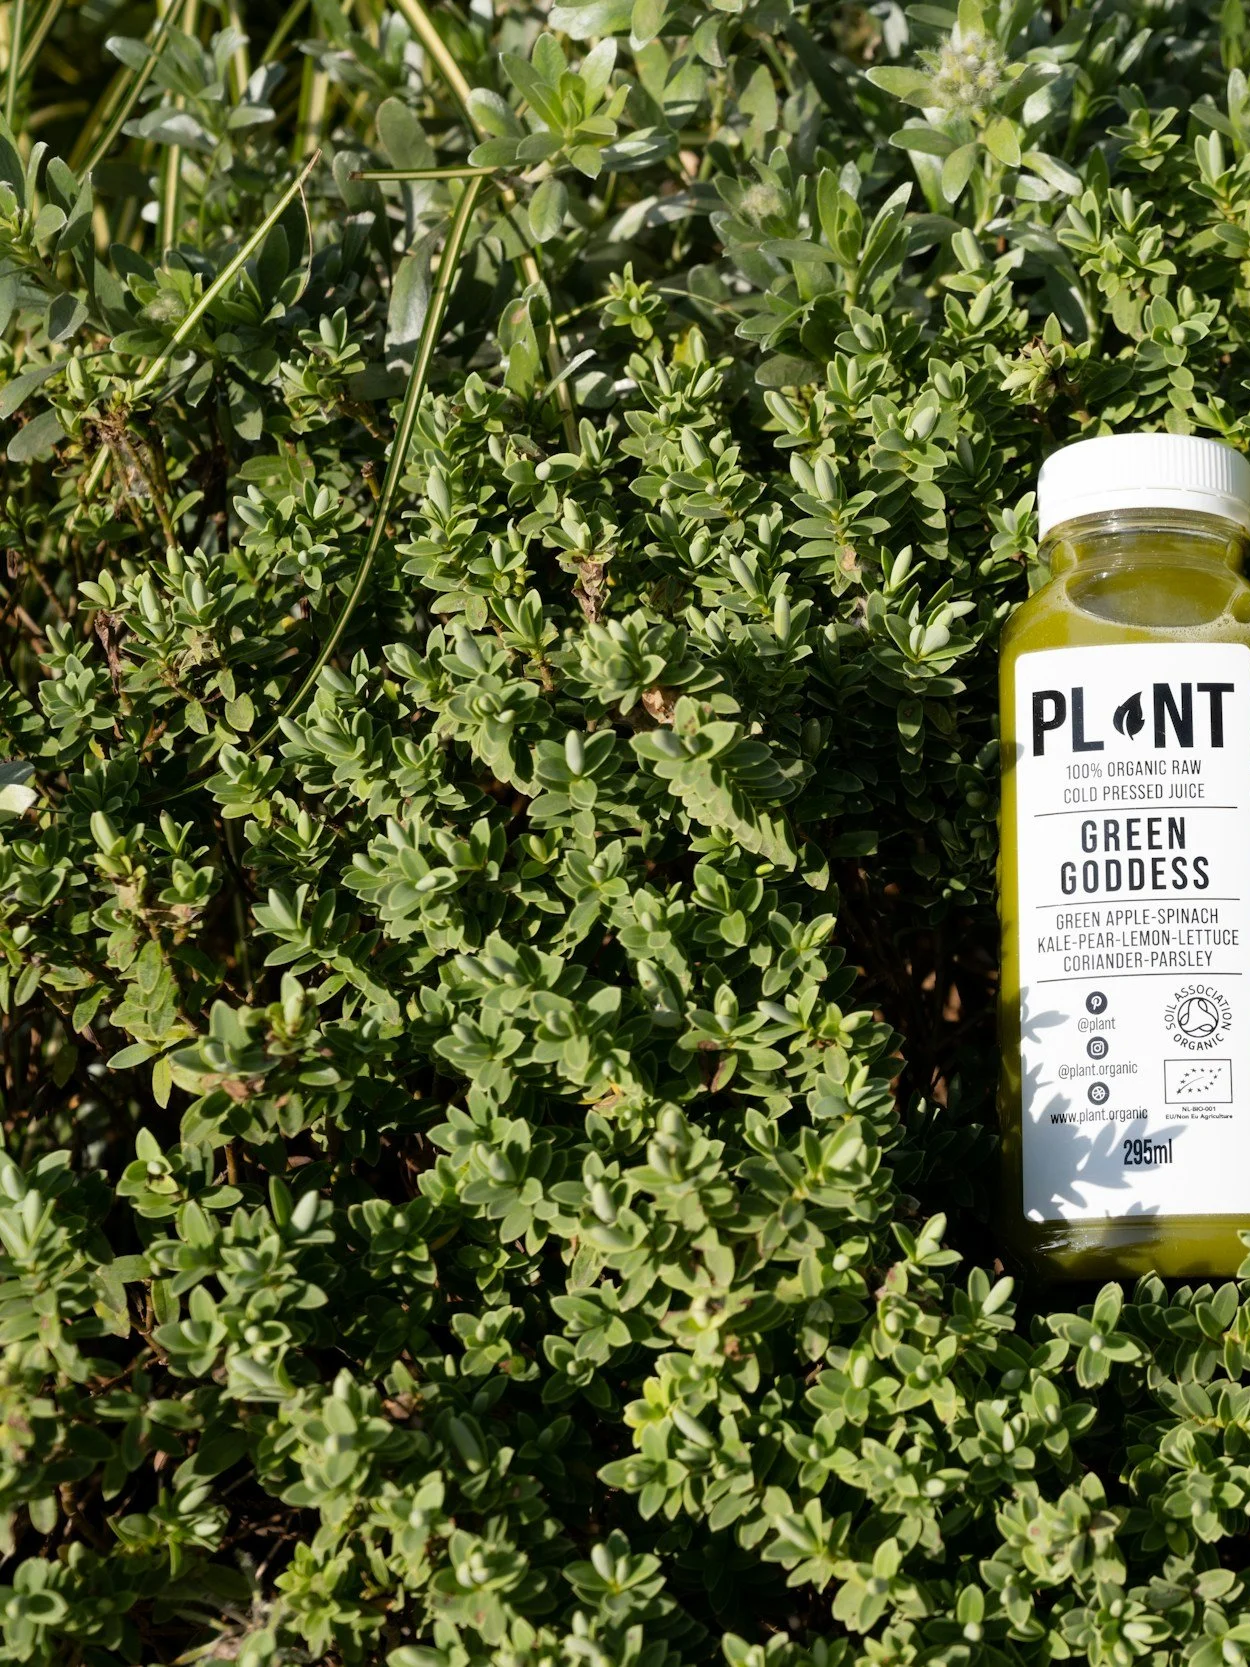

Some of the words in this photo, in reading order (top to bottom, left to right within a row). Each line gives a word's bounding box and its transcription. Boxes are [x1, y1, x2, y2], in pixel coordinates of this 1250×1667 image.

[1066, 763, 1103, 780] 100%
[1107, 760, 1167, 777] ORGANIC
[1172, 759, 1202, 775] RAW
[1063, 786, 1098, 804] COLD
[1103, 784, 1163, 801] PRESSED
[1168, 783, 1205, 799] JUICE
[1081, 816, 1186, 853] GREEN
[1061, 856, 1210, 895] GODDESS
[1056, 911, 1100, 930] GREEN
[1105, 908, 1218, 927] APPLE-SPINACH
[1038, 929, 1239, 953] KALE-PEAR-LEMON-LETTUCE
[1063, 950, 1213, 972] CORIANDER-PARSLEY
[1164, 1004, 1178, 1031] SOIL
[1174, 984, 1233, 1031] ASSOCIATION
[1077, 1016, 1116, 1033] @plant
[1173, 1033, 1225, 1051] ORGANIC
[1058, 1061, 1138, 1080] @plant.organic
[1050, 1106, 1149, 1124] www.plant.organic
[1200, 1113, 1233, 1121] Agriculture
[1123, 1138, 1174, 1165] 295ml
